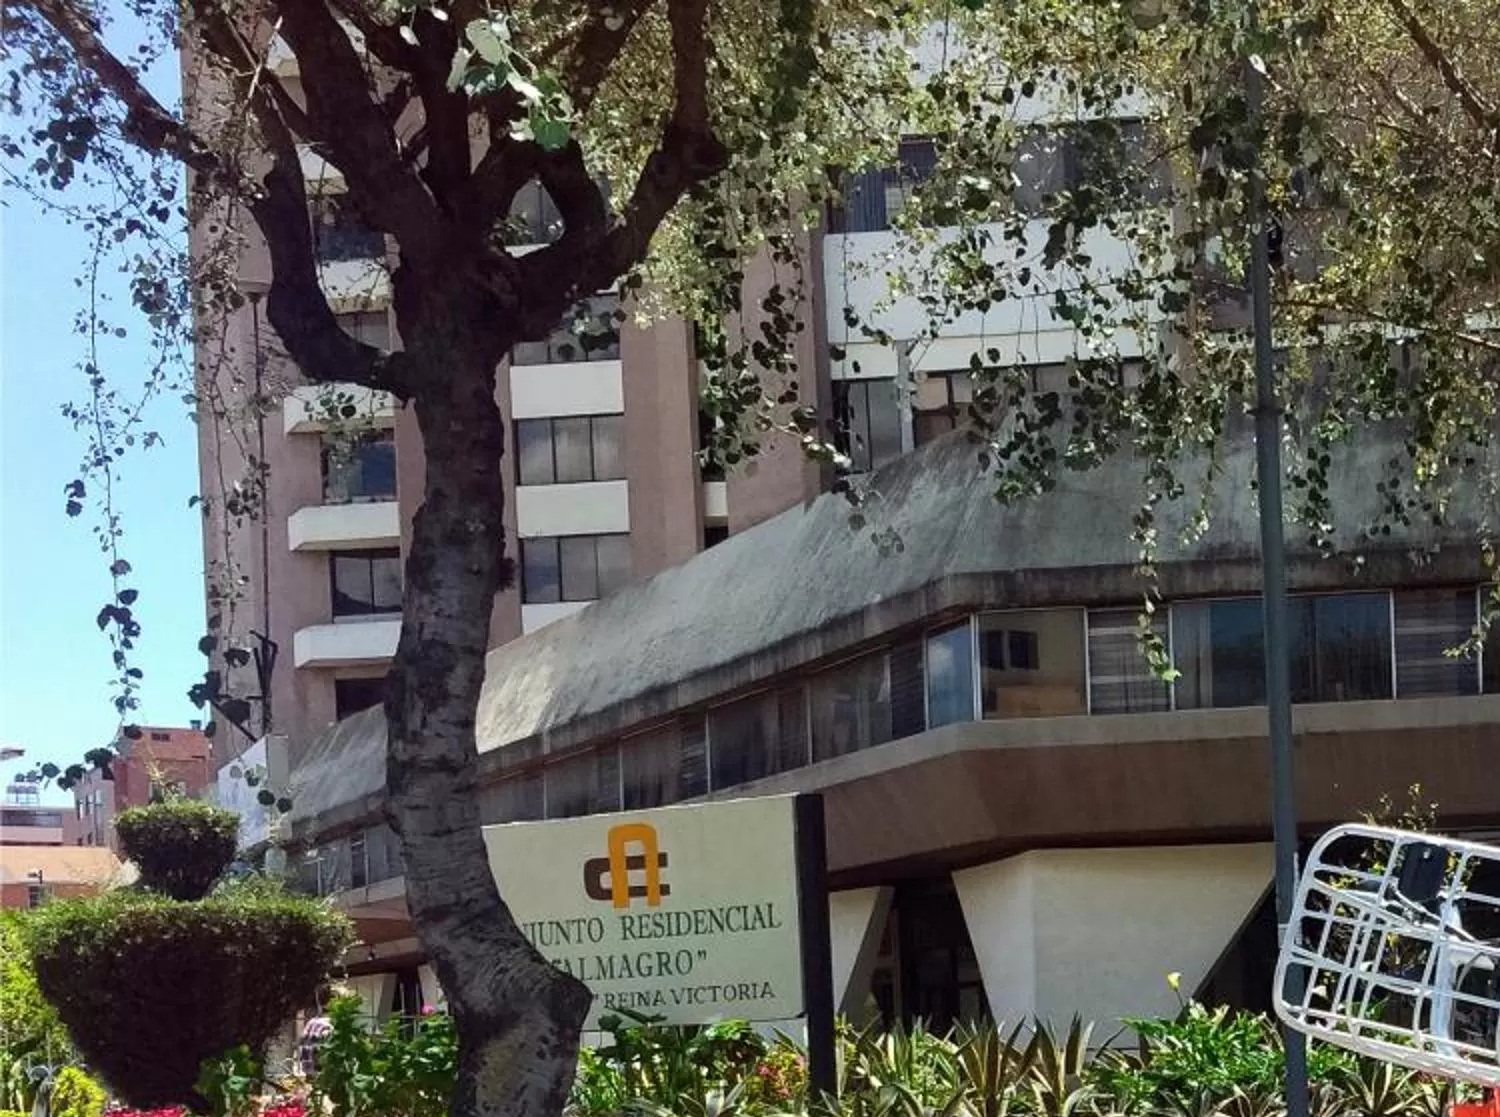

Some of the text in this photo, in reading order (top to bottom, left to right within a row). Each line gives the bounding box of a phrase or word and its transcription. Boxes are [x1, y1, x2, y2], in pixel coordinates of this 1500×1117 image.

[523, 903, 782, 948] JUNTO RESIDENCIAL
[670, 982, 776, 1006] VICTORIA
